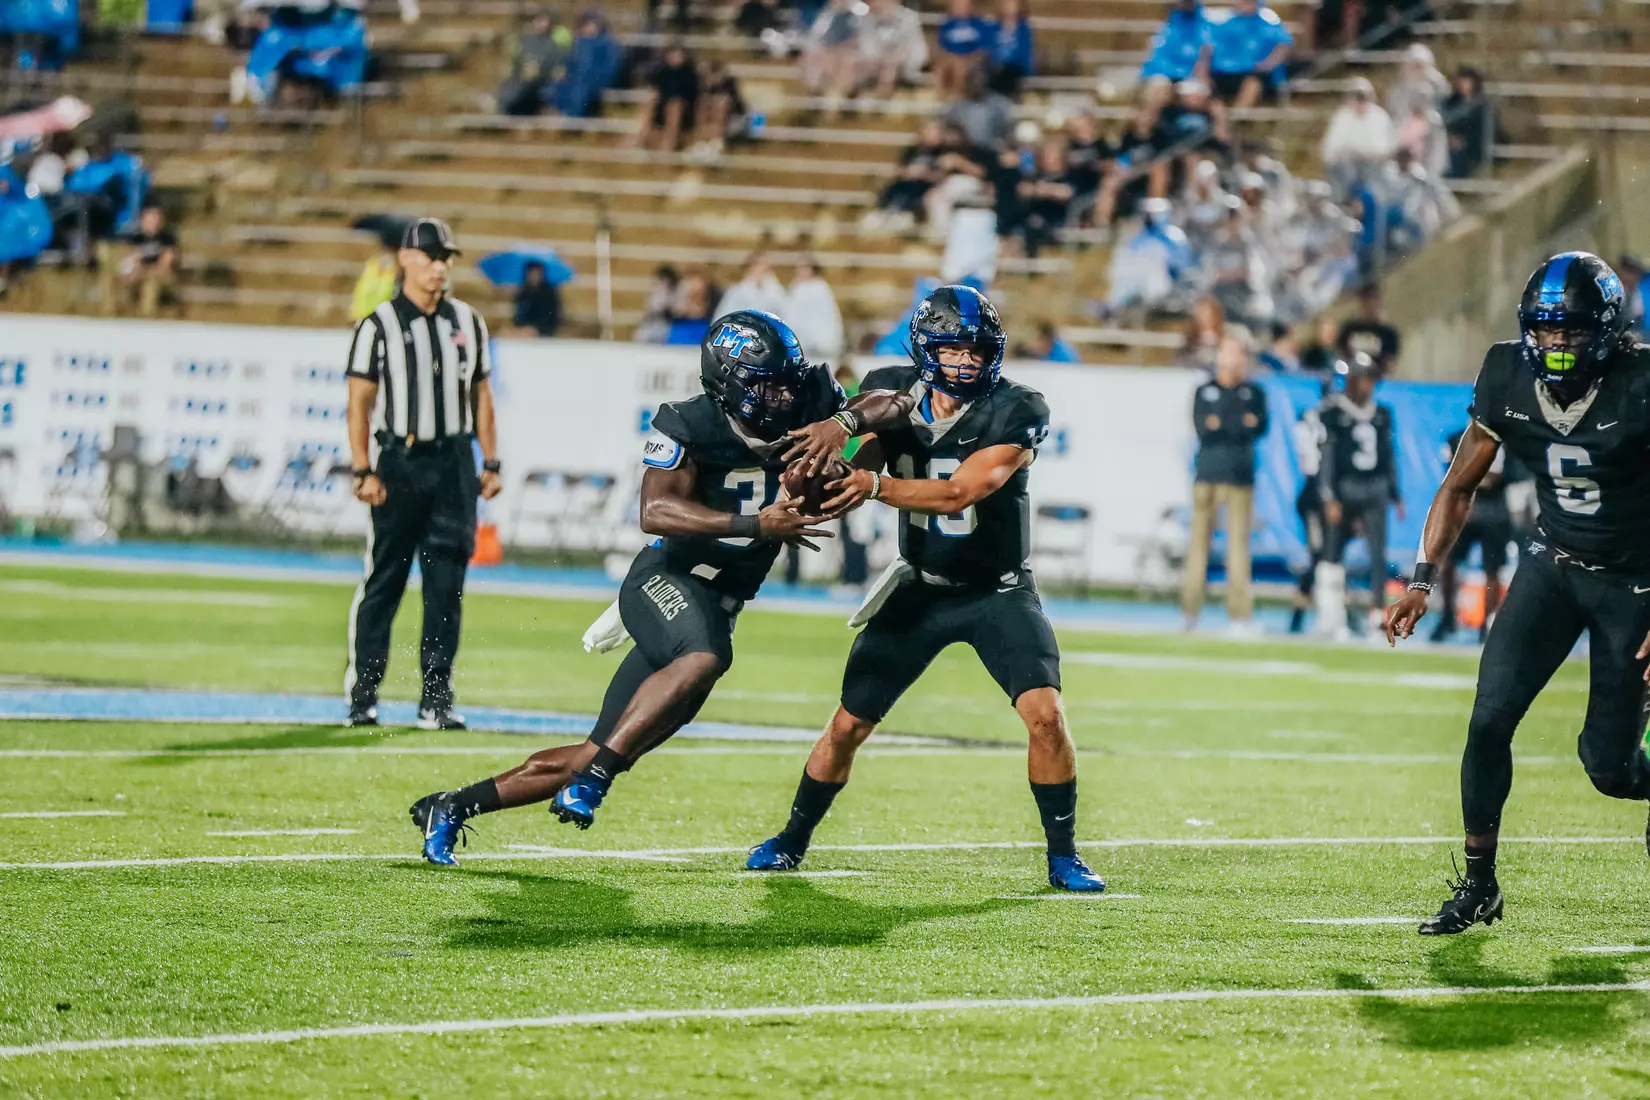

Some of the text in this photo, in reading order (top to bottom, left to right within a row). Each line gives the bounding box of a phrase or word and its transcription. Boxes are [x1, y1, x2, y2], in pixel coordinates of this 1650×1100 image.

[713, 324, 754, 358] MT
[1350, 423, 1378, 471] 3
[1547, 442, 1602, 515] 6
[723, 466, 766, 547] 3
[641, 574, 689, 621] RAIDERS
